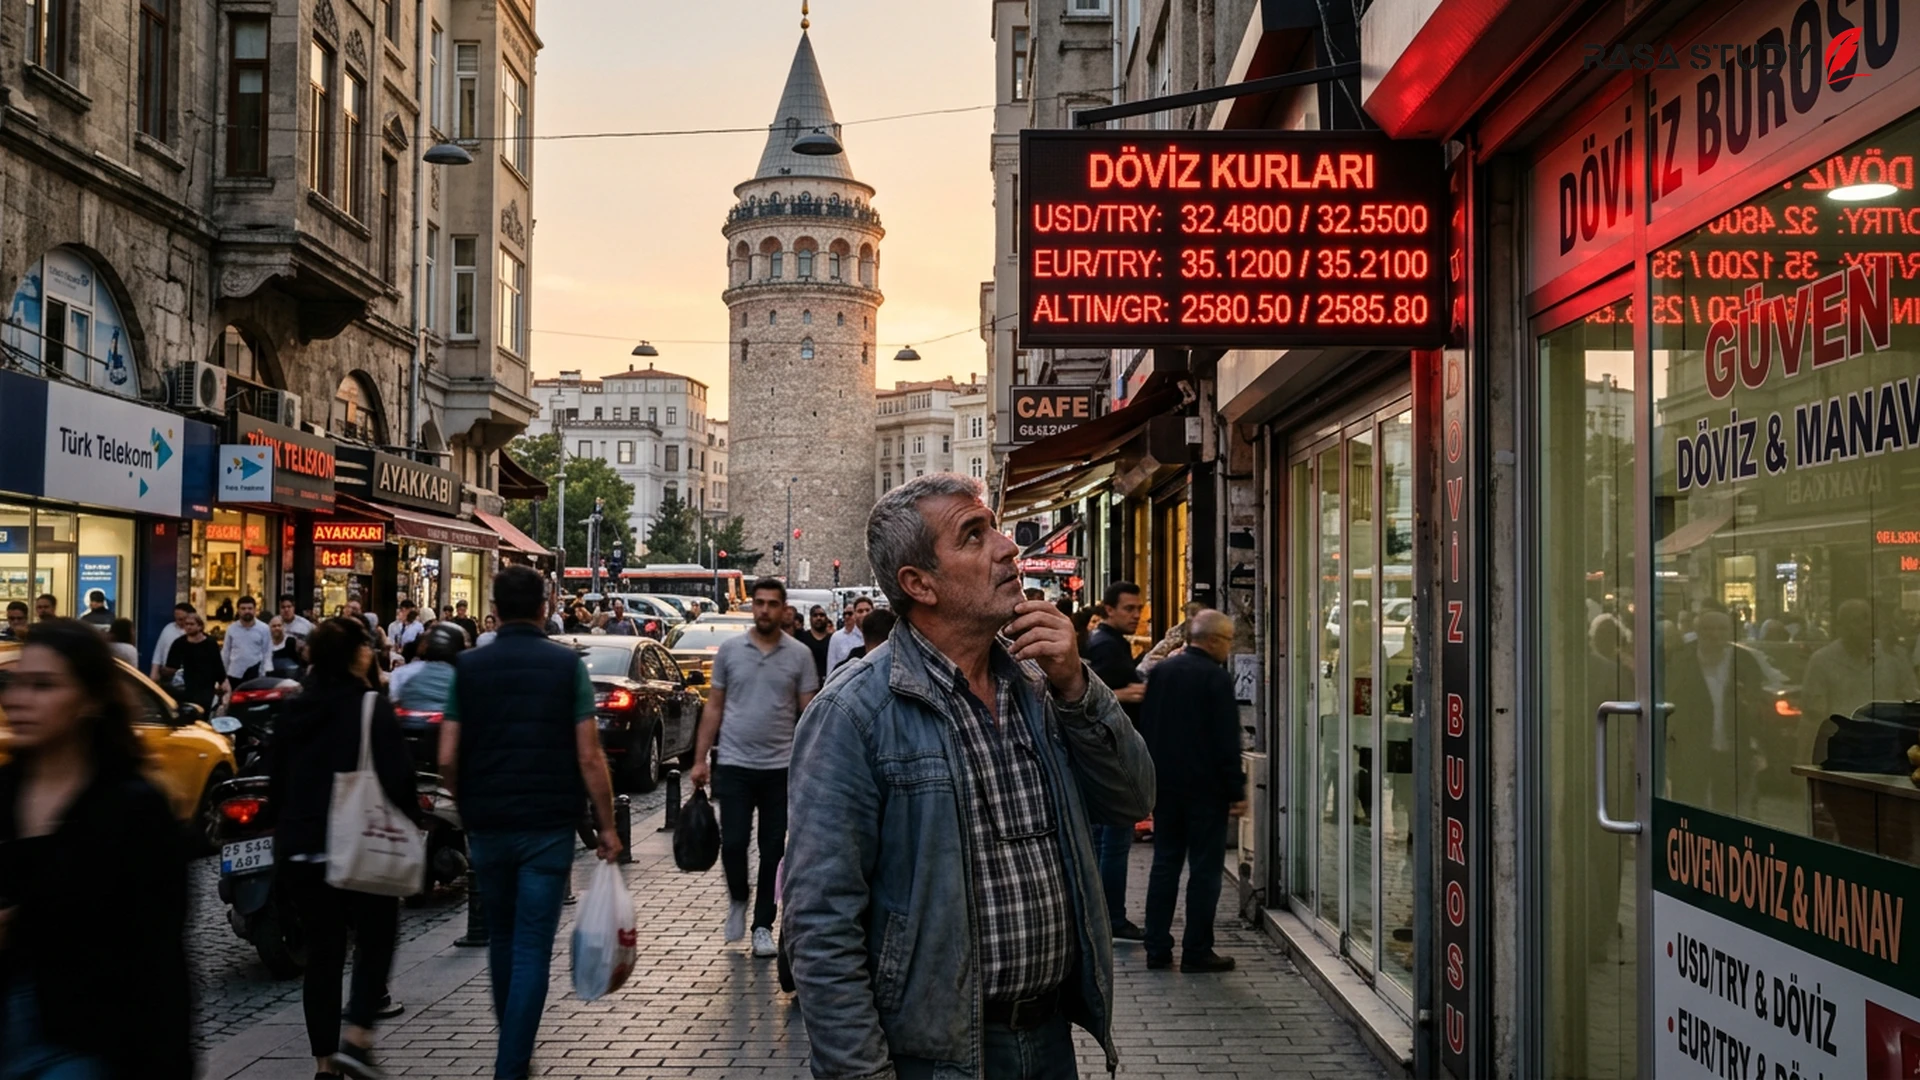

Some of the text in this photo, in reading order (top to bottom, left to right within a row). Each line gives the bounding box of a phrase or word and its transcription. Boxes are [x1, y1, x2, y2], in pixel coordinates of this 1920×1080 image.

[1089, 145, 1374, 189] DÖVİZ KURLARI
[1033, 203, 1163, 234] USD/TRY:
[1181, 203, 1292, 234] 32.4800
[1317, 203, 1428, 235] 32.5500
[1033, 248, 1163, 279] EUR/TRY:
[1181, 248, 1292, 279] 35.1200
[1317, 248, 1428, 280] 35.2100
[1033, 294, 1170, 324] ALTIN/GR:
[1181, 293, 1292, 324] 2580.50
[1317, 293, 1428, 325] 2585.80
[1704, 254, 1890, 400] GÜVEN
[1017, 396, 1089, 418] CAFE
[60, 427, 153, 469] Türk Telekom
[1677, 374, 1920, 491] DÖVİZ & MANAV
[379, 462, 452, 506] AYAKKABI
[1446, 693, 1465, 1055] BUROSU
[1667, 817, 1903, 965] GÜVEN DÖVİZ & MANAV
[1677, 932, 1837, 1057] USD/TRY & DÖVİZ
[1678, 1007, 1751, 1080] EUR/TRY
